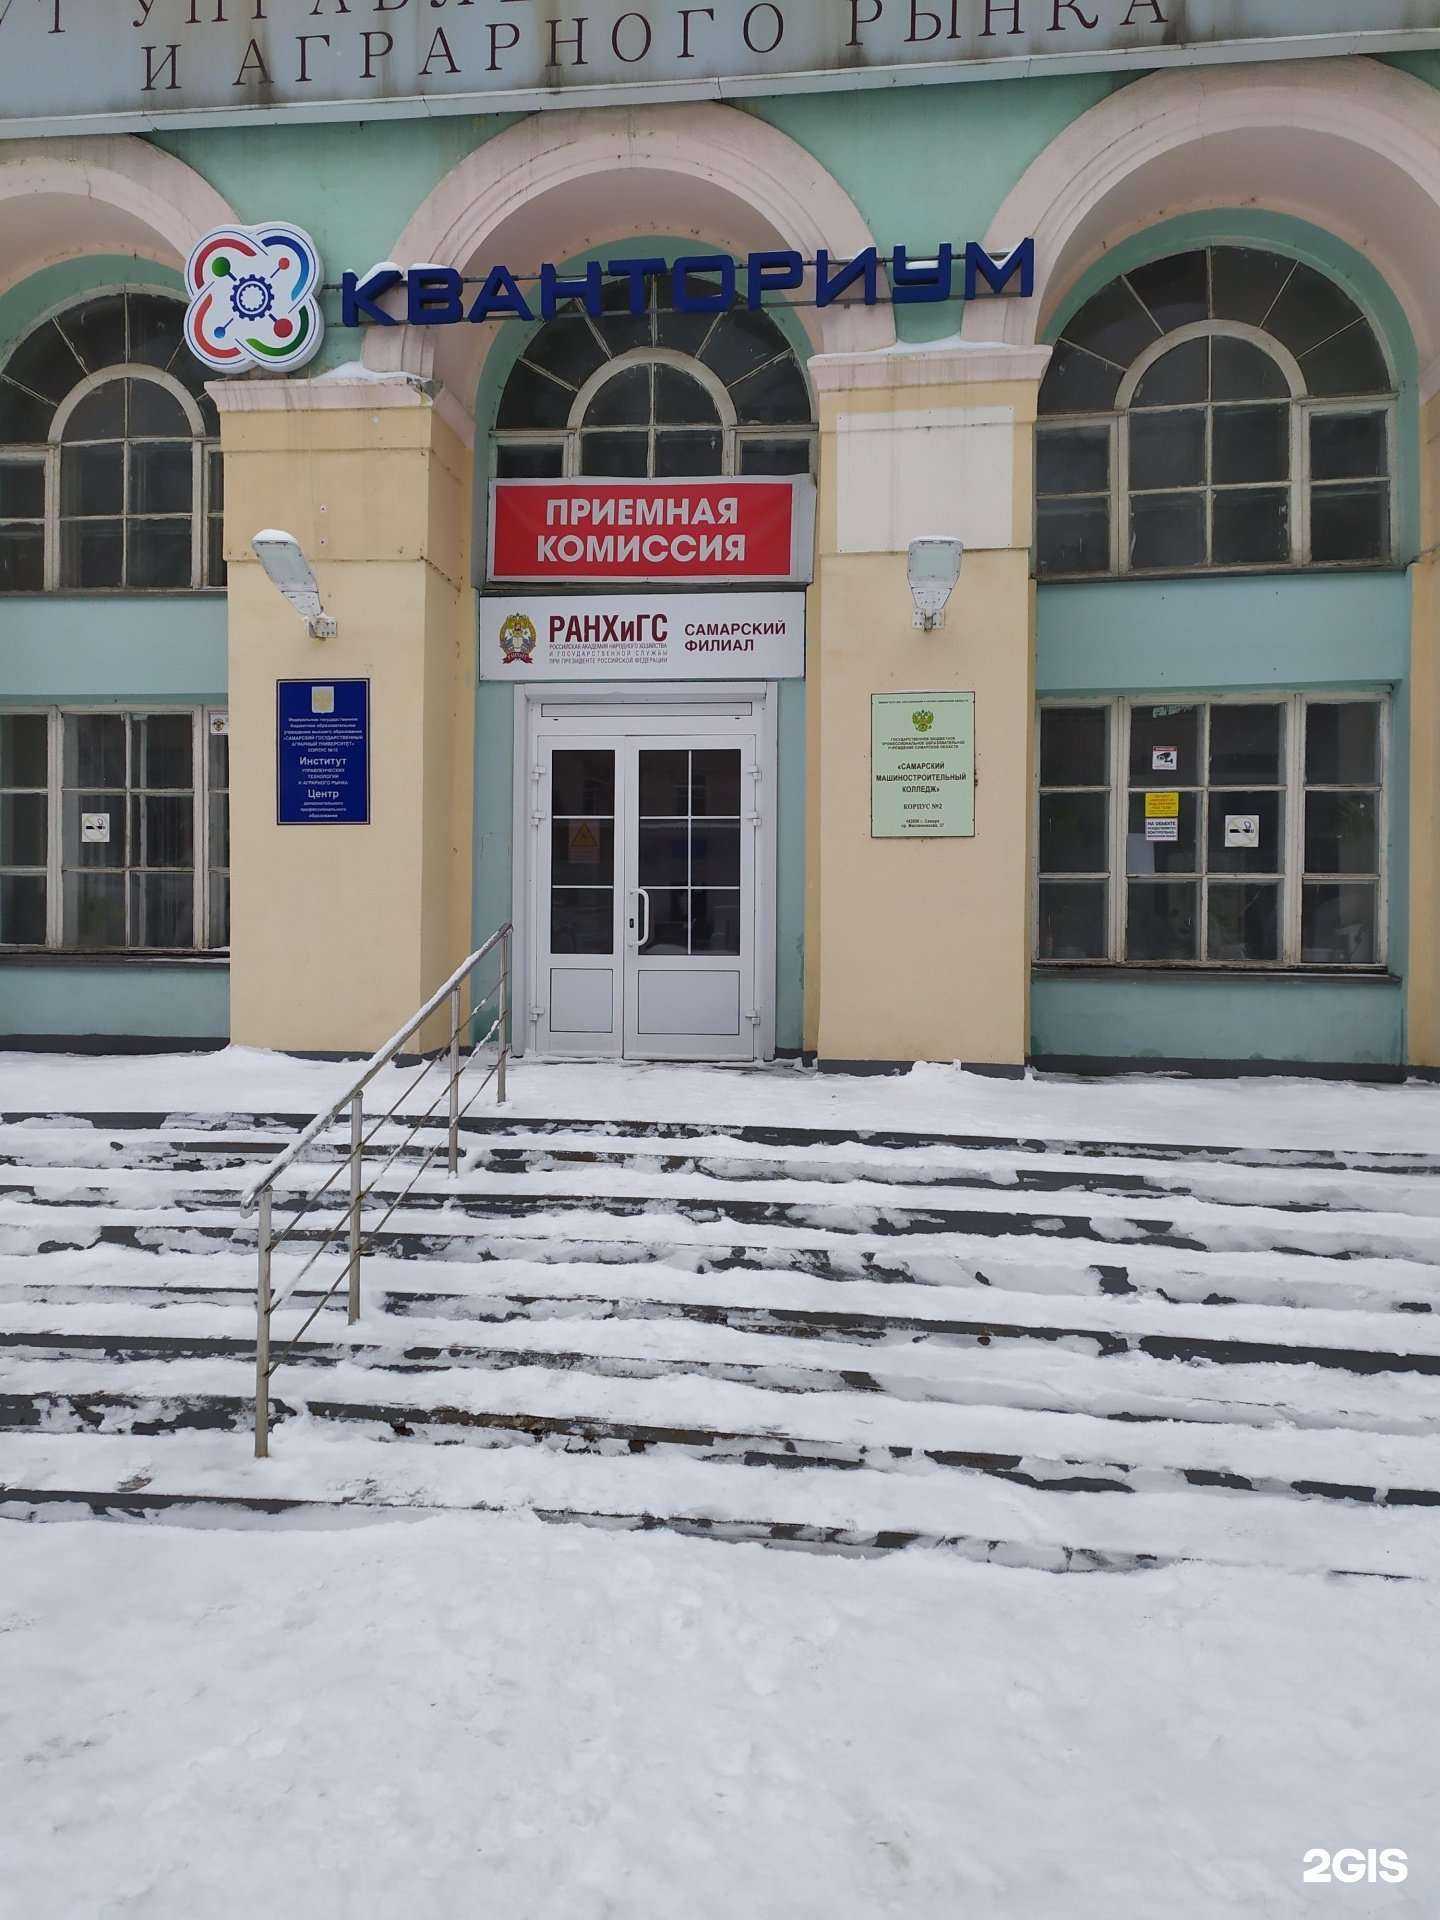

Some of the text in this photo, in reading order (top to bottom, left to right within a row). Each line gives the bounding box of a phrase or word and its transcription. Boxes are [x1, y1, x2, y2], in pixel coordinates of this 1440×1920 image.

[140, 45, 183, 91] И
[232, 2, 785, 87] АГРАРНОГО
[844, 0, 1169, 46] РЫНКА
[341, 237, 1035, 328] КВАНТОРИУМ
[546, 497, 738, 526] ПРИЕМНАЯ
[536, 534, 746, 562] КОМИССИЯ
[549, 613, 669, 643] РАНХиГС
[684, 619, 786, 637] САМАРСКИЙ
[684, 638, 755, 652] ФИЛИАЛ
[299, 756, 347, 767] Институт
[897, 761, 945, 770] «САМАРСКИЙ
[876, 772, 967, 782] МАШИНОСТРОИТЕЛЬНЫЙ
[307, 789, 339, 800] Центр
